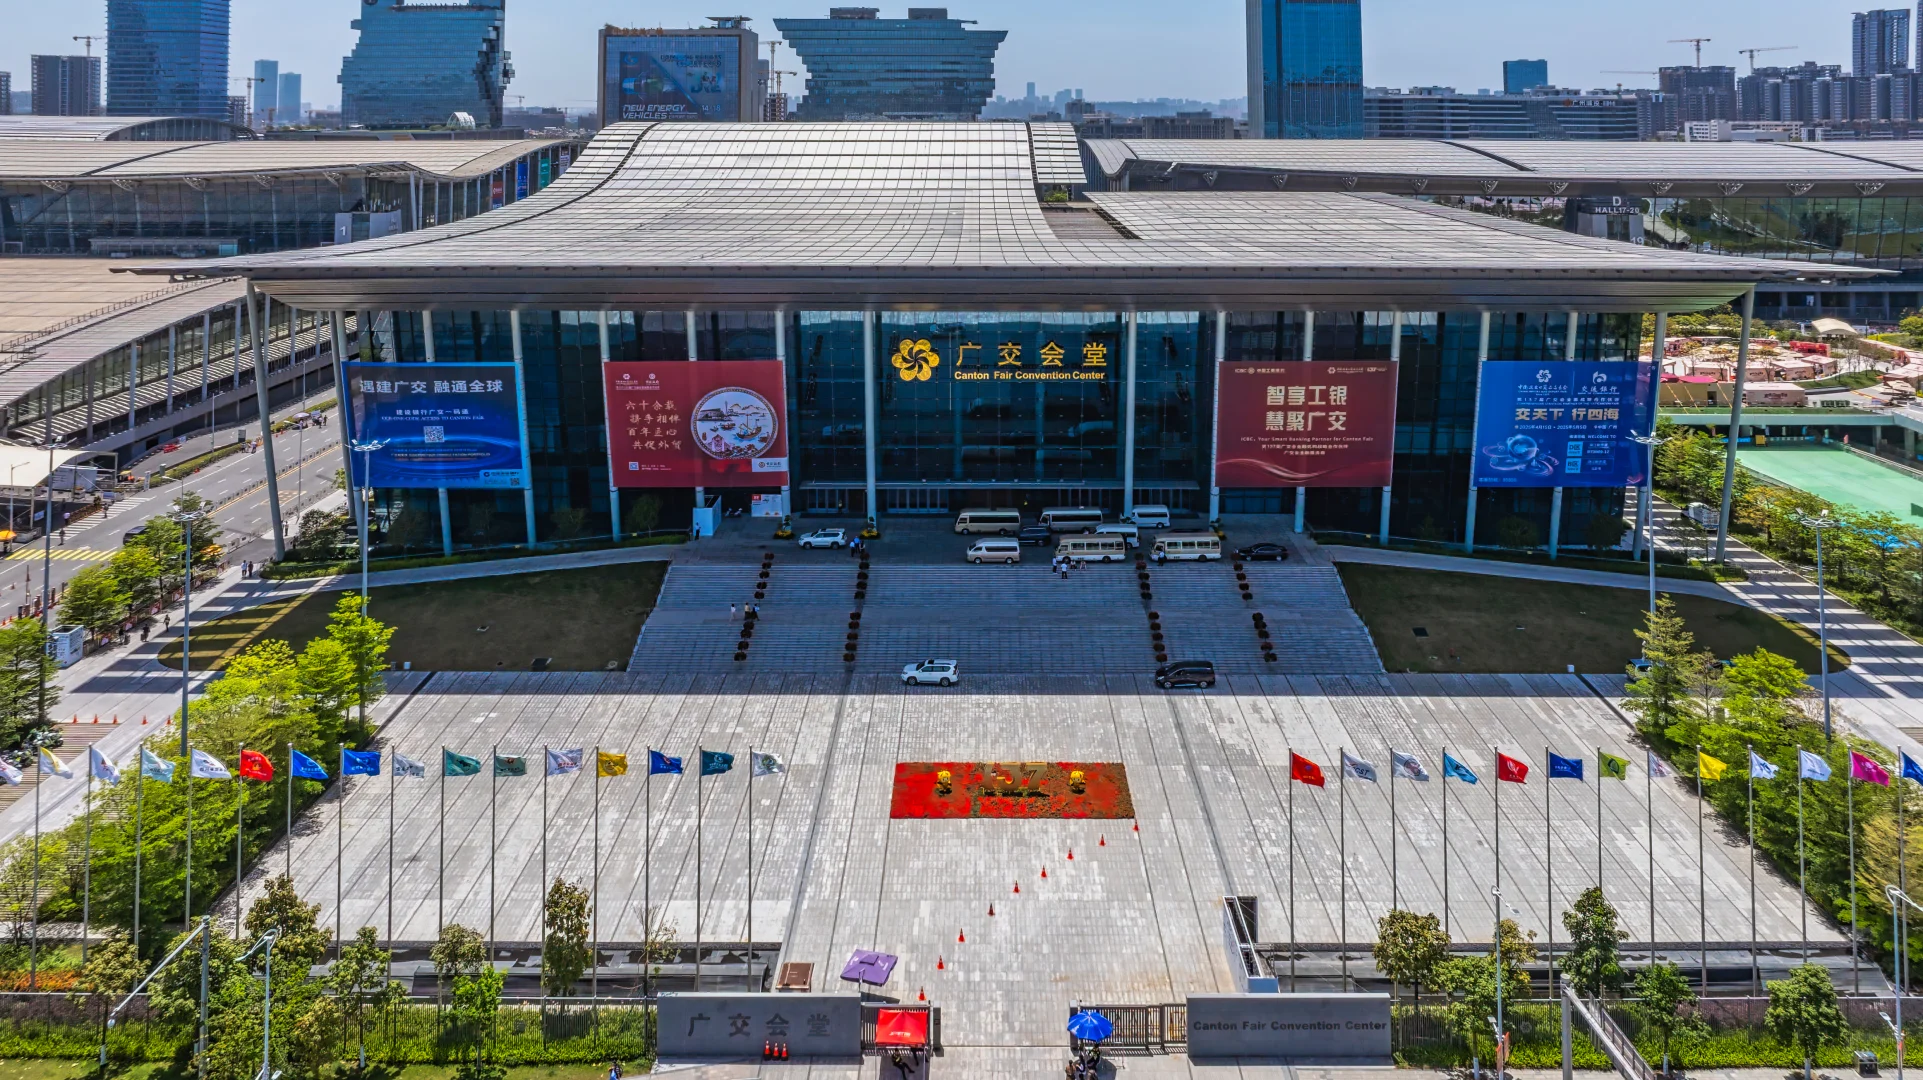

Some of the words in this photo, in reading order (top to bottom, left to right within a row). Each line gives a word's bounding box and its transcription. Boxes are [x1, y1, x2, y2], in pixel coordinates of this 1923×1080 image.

[647, 104, 686, 112] ENERGY
[1612, 196, 1622, 206] D
[340, 225, 347, 236] 1
[1630, 236, 1644, 246] 19
[956, 341, 1107, 367] 广交会堂
[954, 371, 990, 380] Canton
[993, 371, 1013, 380] Fair
[1015, 371, 1071, 380] Convention
[1072, 371, 1105, 380] Center
[360, 380, 427, 394] 遇建广交
[434, 379, 503, 394] 融通全球
[1266, 385, 1348, 406] 智享工银
[1515, 407, 1565, 421] 交天下
[1571, 407, 1620, 421] 行四海
[1265, 410, 1347, 431] 慧聚广交
[687, 1013, 831, 1037] 广交会堂
[1193, 1021, 1237, 1031] Canton
[1242, 1020, 1266, 1031] Fair
[1270, 1020, 1341, 1031] Convention
[1345, 1020, 1387, 1031] Center
